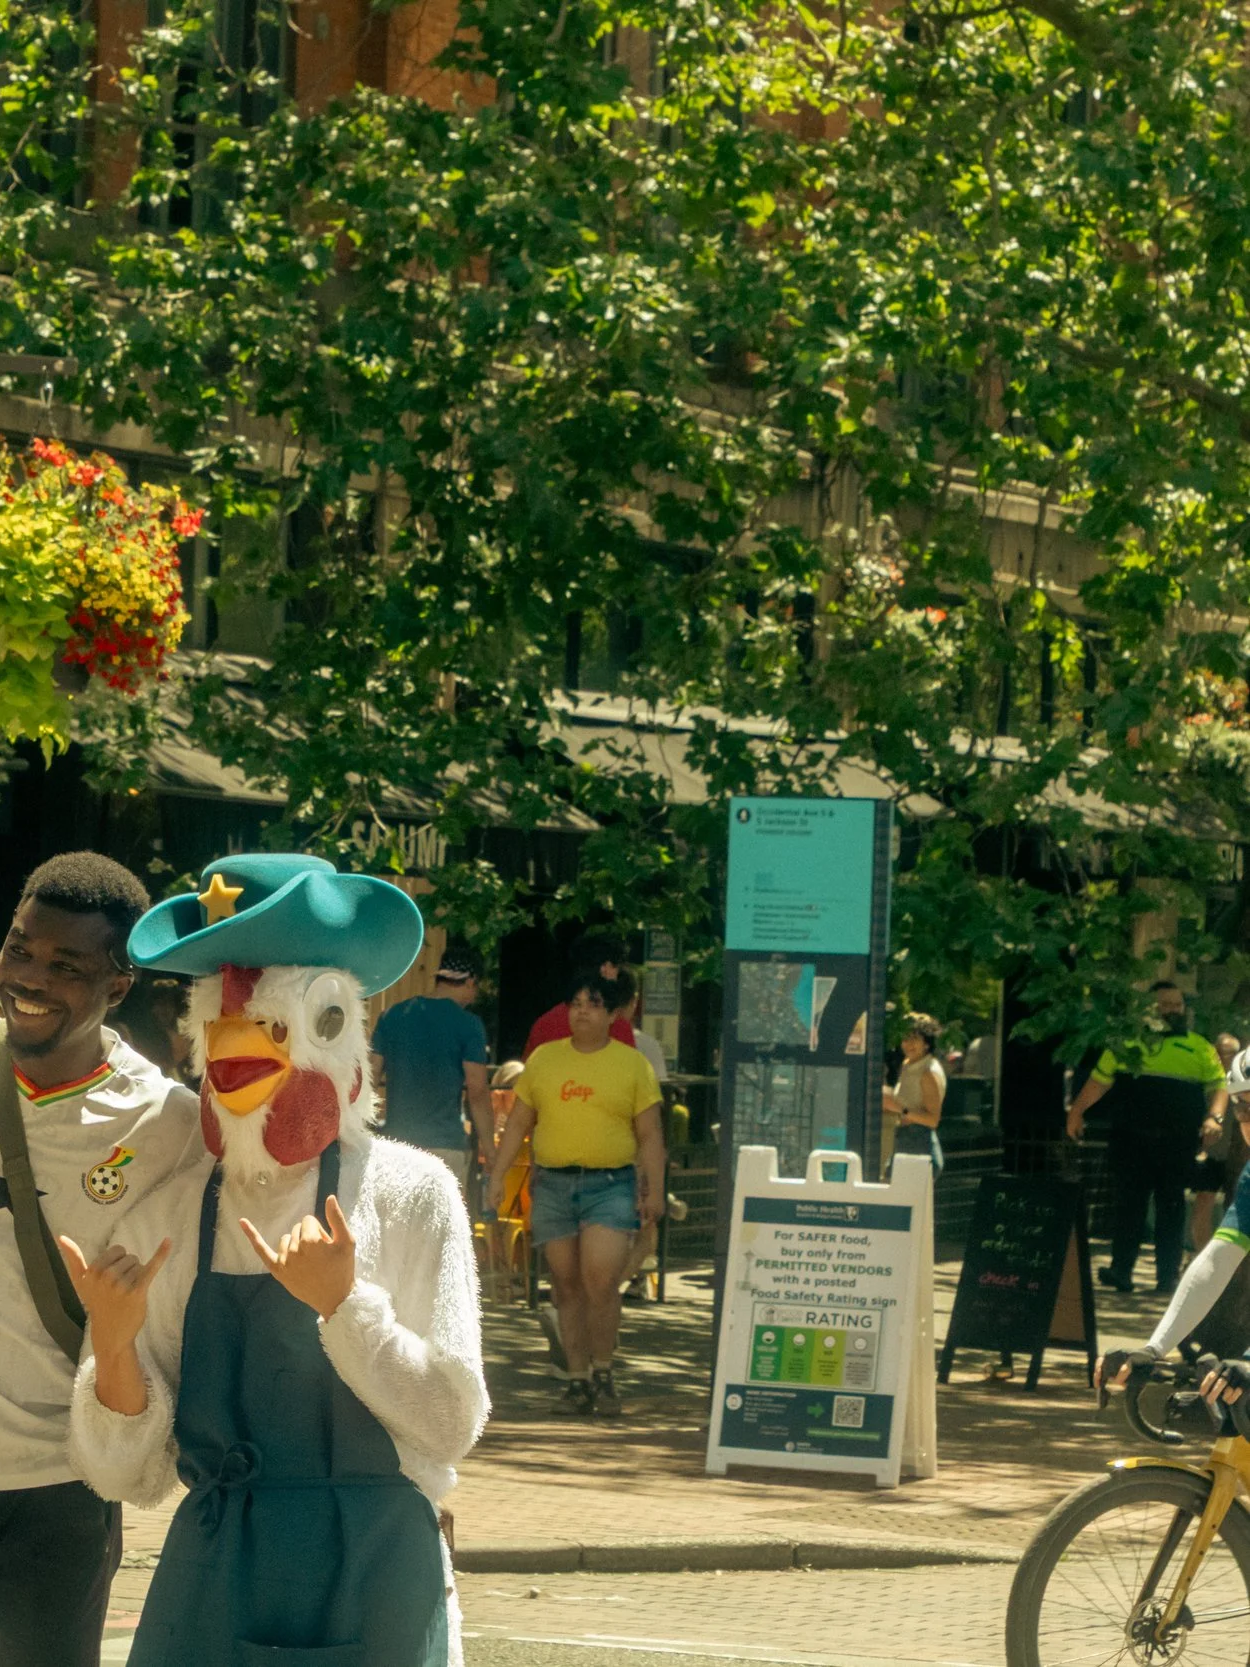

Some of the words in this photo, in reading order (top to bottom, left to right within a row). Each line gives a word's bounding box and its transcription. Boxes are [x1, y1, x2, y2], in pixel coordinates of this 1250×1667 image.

[352, 820, 447, 868] SAUMI
[774, 1230, 794, 1240] For
[798, 1231, 837, 1243] SAFER
[841, 1234, 871, 1247] food,
[781, 1246, 803, 1259] buy
[807, 1248, 832, 1260] only
[837, 1249, 866, 1260] from
[755, 1258, 827, 1272] PERMITTED
[832, 1263, 893, 1277] VENDORS
[772, 1274, 799, 1284] with
[803, 1277, 811, 1286] a
[814, 1276, 856, 1289] posted
[750, 1288, 780, 1299] Food
[784, 1289, 823, 1304] Safety
[827, 1292, 867, 1306] Rating
[871, 1296, 897, 1308] sign
[805, 1310, 873, 1329] RATING
